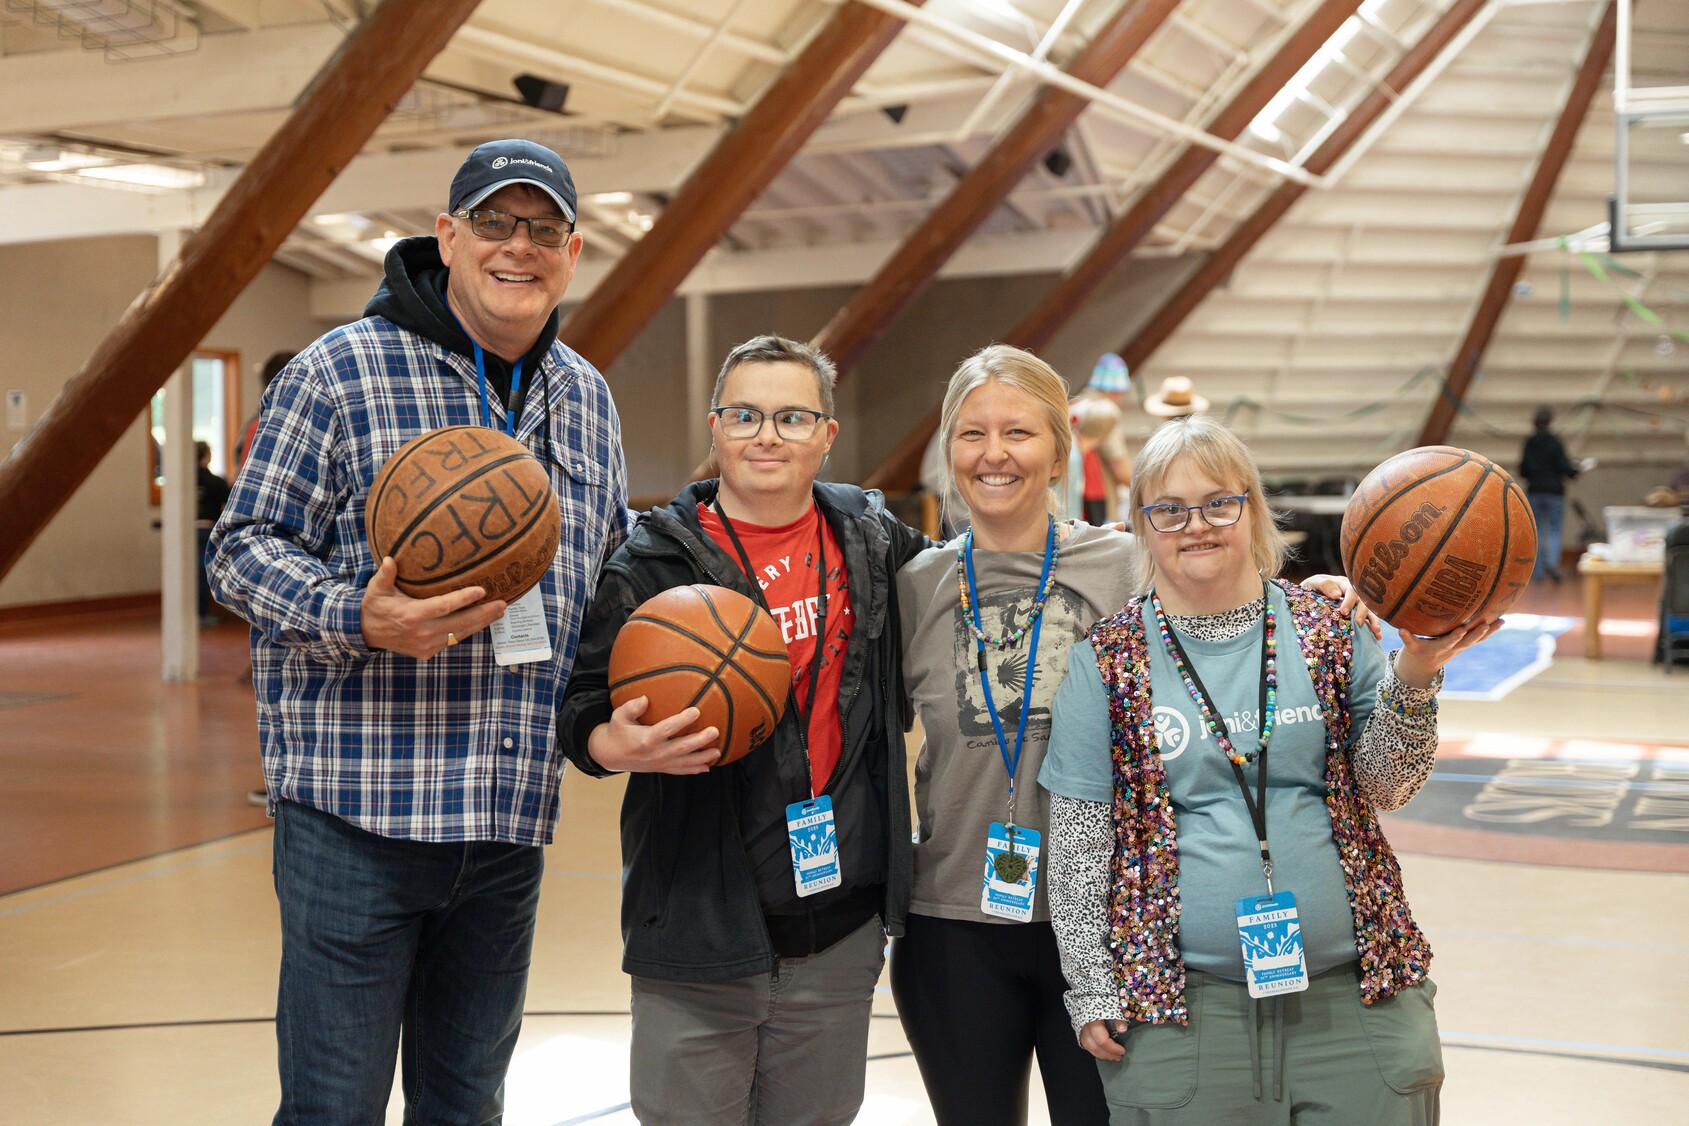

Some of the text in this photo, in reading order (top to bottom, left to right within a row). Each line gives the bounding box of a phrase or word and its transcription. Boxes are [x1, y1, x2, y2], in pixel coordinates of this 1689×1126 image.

[410, 468, 544, 573] TRFC
[1358, 500, 1448, 606] Wilson
[1424, 553, 1488, 610] NBA
[796, 813, 828, 828] FAMILY
[997, 841, 1032, 854] FAILY
[803, 875, 837, 890] REUNION
[988, 902, 1027, 916] REUNION
[1248, 911, 1289, 924] FAMILY
[1257, 978, 1302, 991] REUNION
